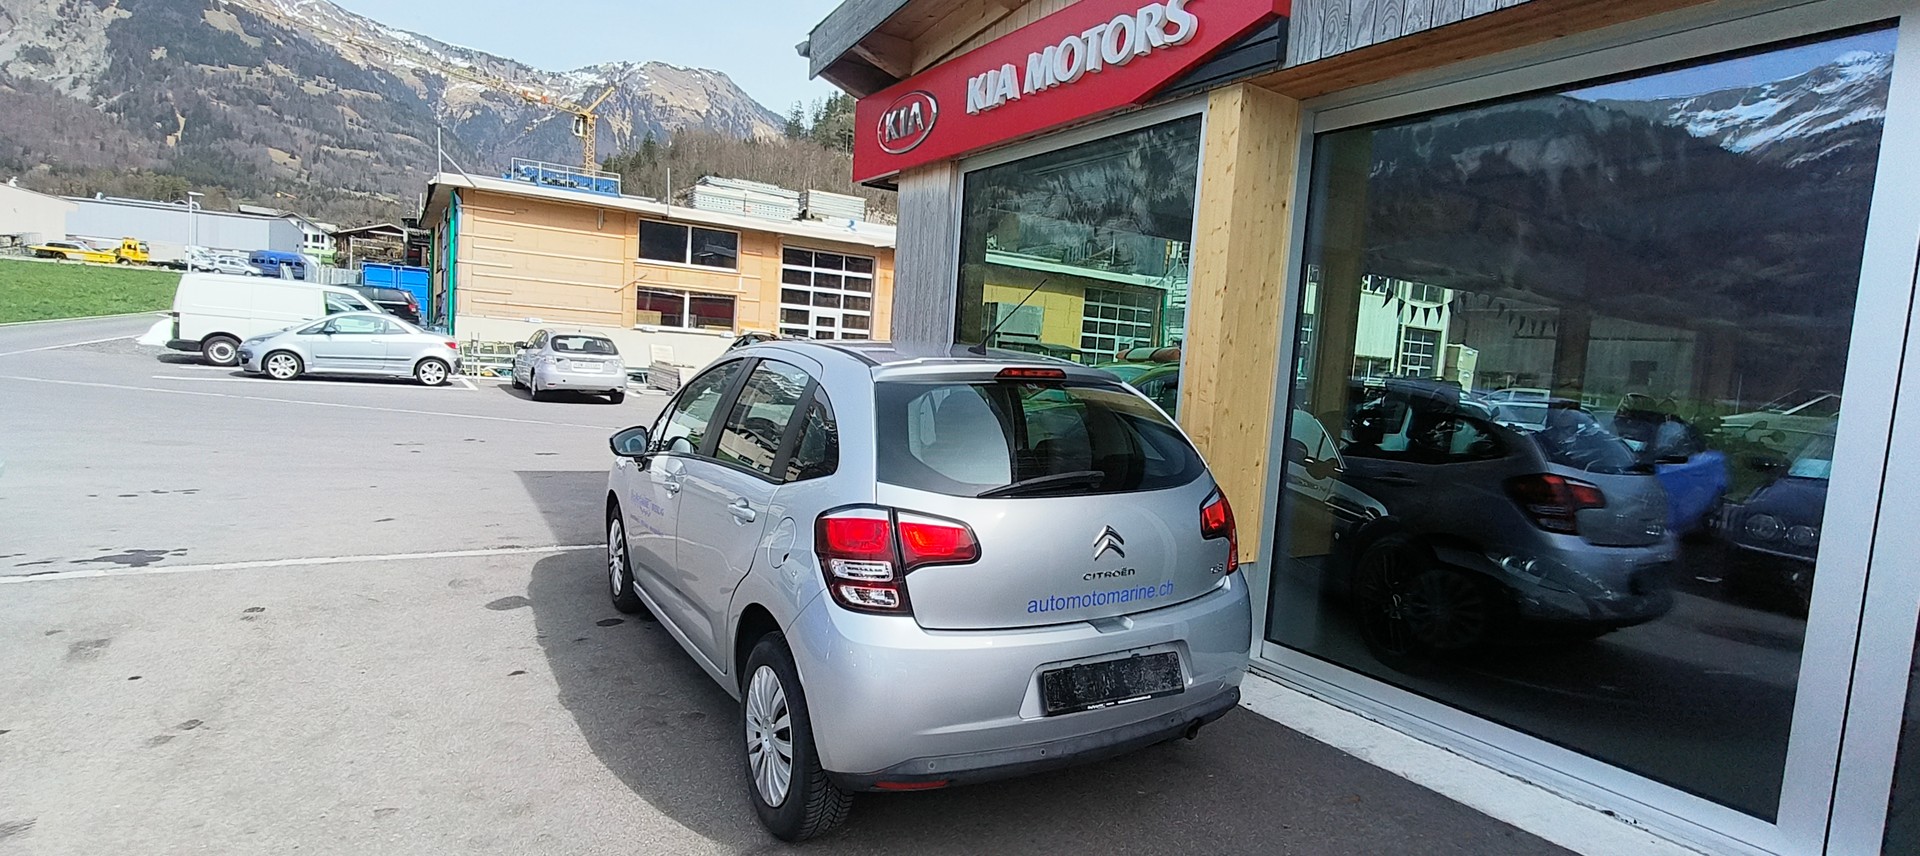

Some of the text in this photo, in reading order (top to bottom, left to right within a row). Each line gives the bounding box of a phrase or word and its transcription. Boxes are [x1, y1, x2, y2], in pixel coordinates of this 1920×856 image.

[966, 0, 1198, 115] KIA MOTORS
[885, 102, 924, 142] KIA
[1027, 580, 1174, 613] automotomarine.ch
